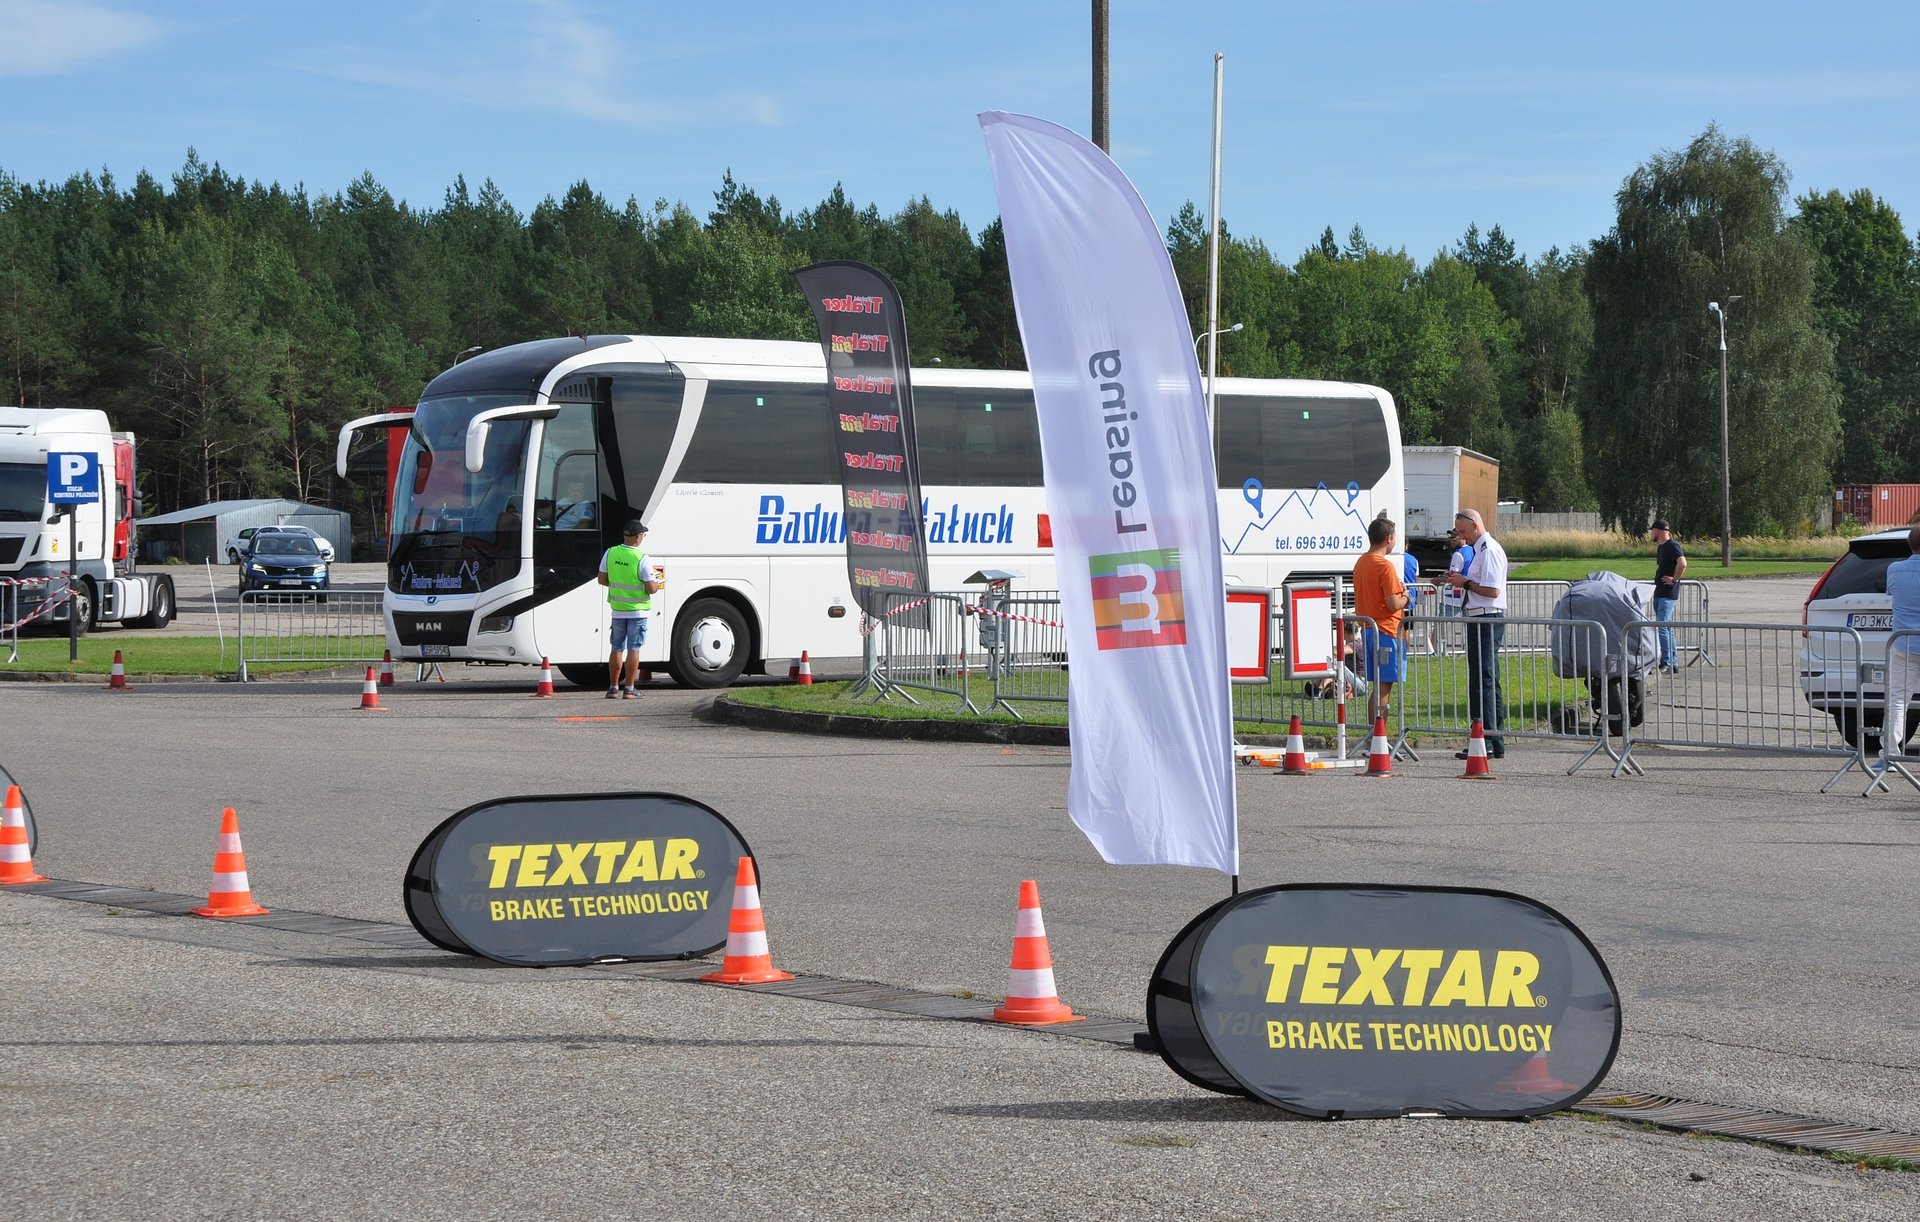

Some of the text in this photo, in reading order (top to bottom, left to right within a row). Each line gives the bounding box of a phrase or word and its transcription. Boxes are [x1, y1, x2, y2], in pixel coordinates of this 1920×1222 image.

[60, 454, 88, 485] P
[1275, 536, 1363, 549] tel. 696 340 145
[415, 622, 442, 632] MAN
[1853, 615, 1867, 627] PO
[489, 897, 566, 922] BRAKE
[568, 890, 710, 918] TECHNOLOGY
[1266, 1020, 1363, 1051] BRAKE
[1367, 1022, 1553, 1053] TECHNOLOGY
